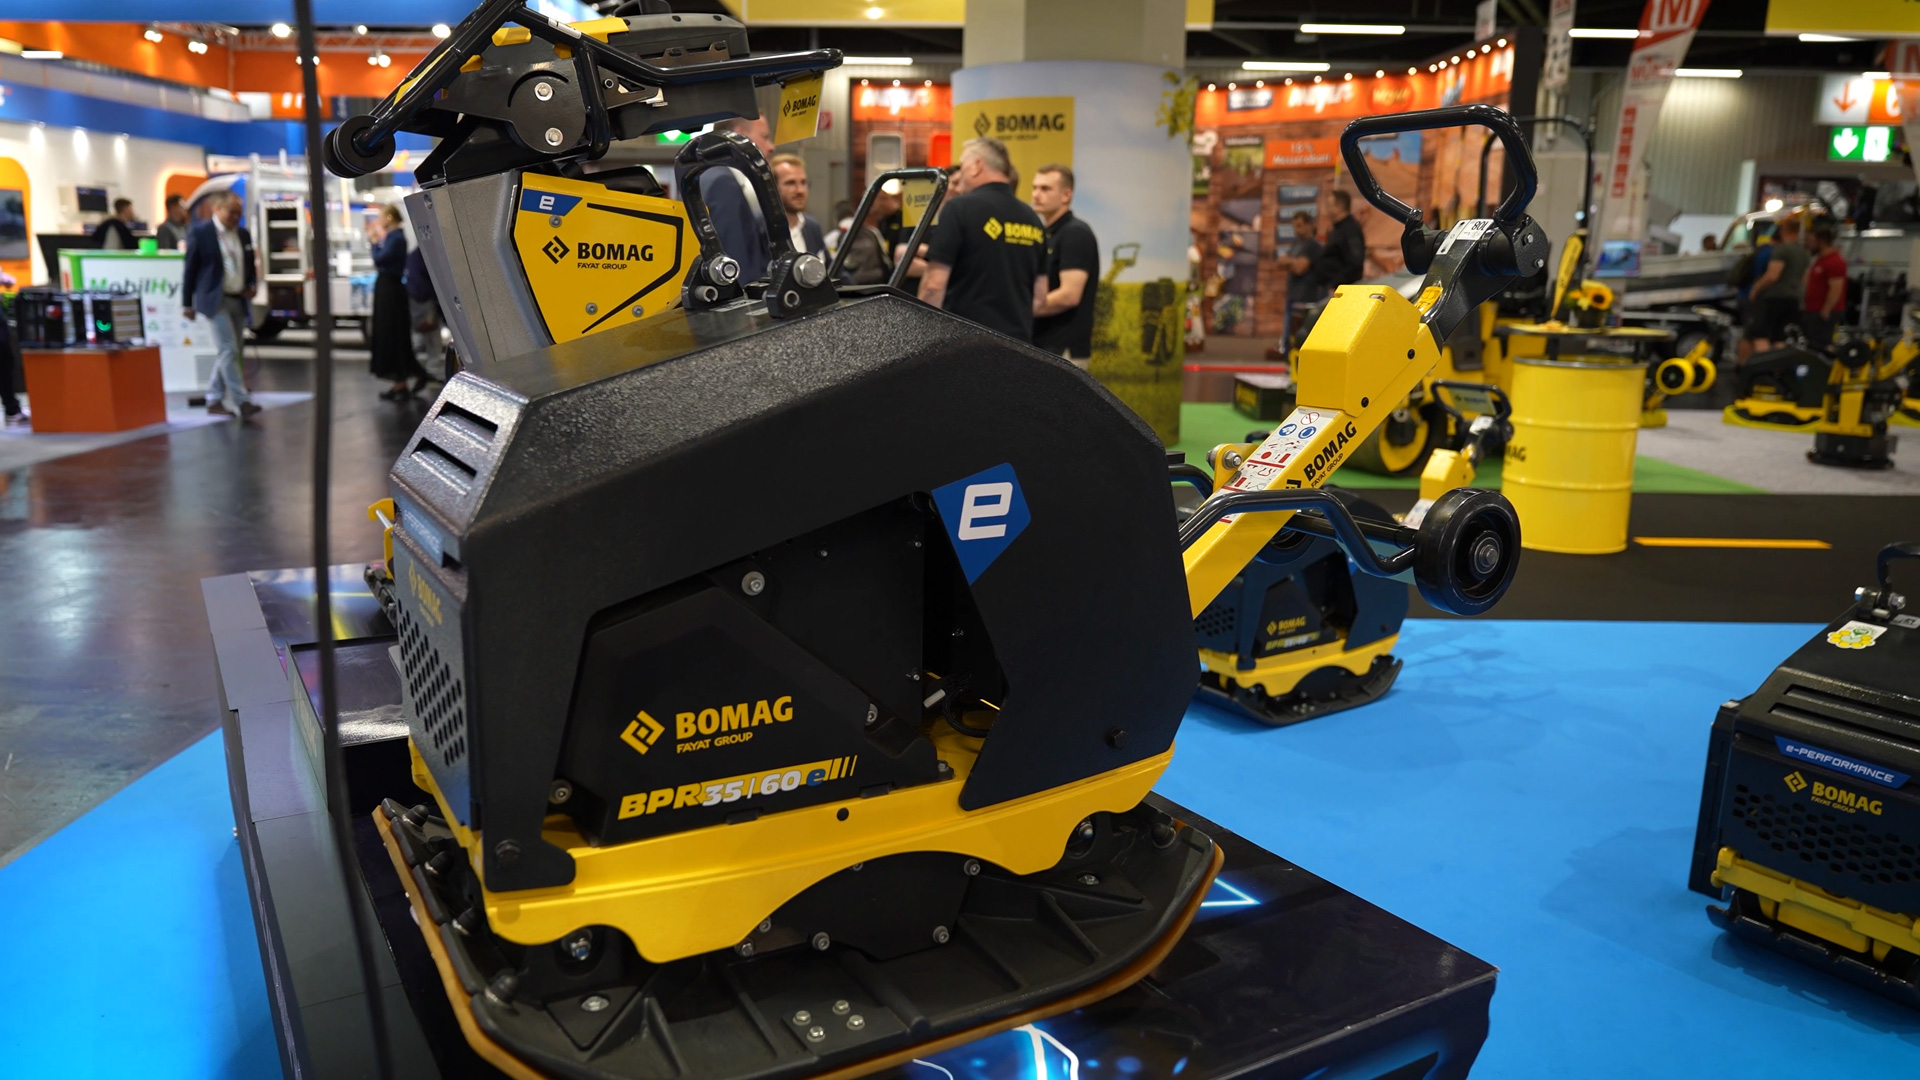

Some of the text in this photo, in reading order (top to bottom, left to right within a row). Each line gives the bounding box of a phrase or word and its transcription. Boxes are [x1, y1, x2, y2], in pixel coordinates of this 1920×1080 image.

[793, 95, 817, 111] BOMAG
[996, 113, 1065, 131] BOMAG
[539, 196, 556, 211] e
[1004, 222, 1044, 244] BOMAG
[577, 243, 653, 261] BOMAG
[90, 278, 182, 297] MobilHy
[1303, 421, 1357, 482] BOMAG
[1311, 453, 1344, 488] FAYAT GROUP
[958, 482, 1013, 541] e
[676, 696, 794, 740] BOMAG
[677, 732, 753, 754] FAYAT GROUP
[1786, 744, 1895, 783] e-PERFORMANCE
[1811, 795, 1858, 814] FAYAT GROUP
[1812, 781, 1884, 816] BOMAG
